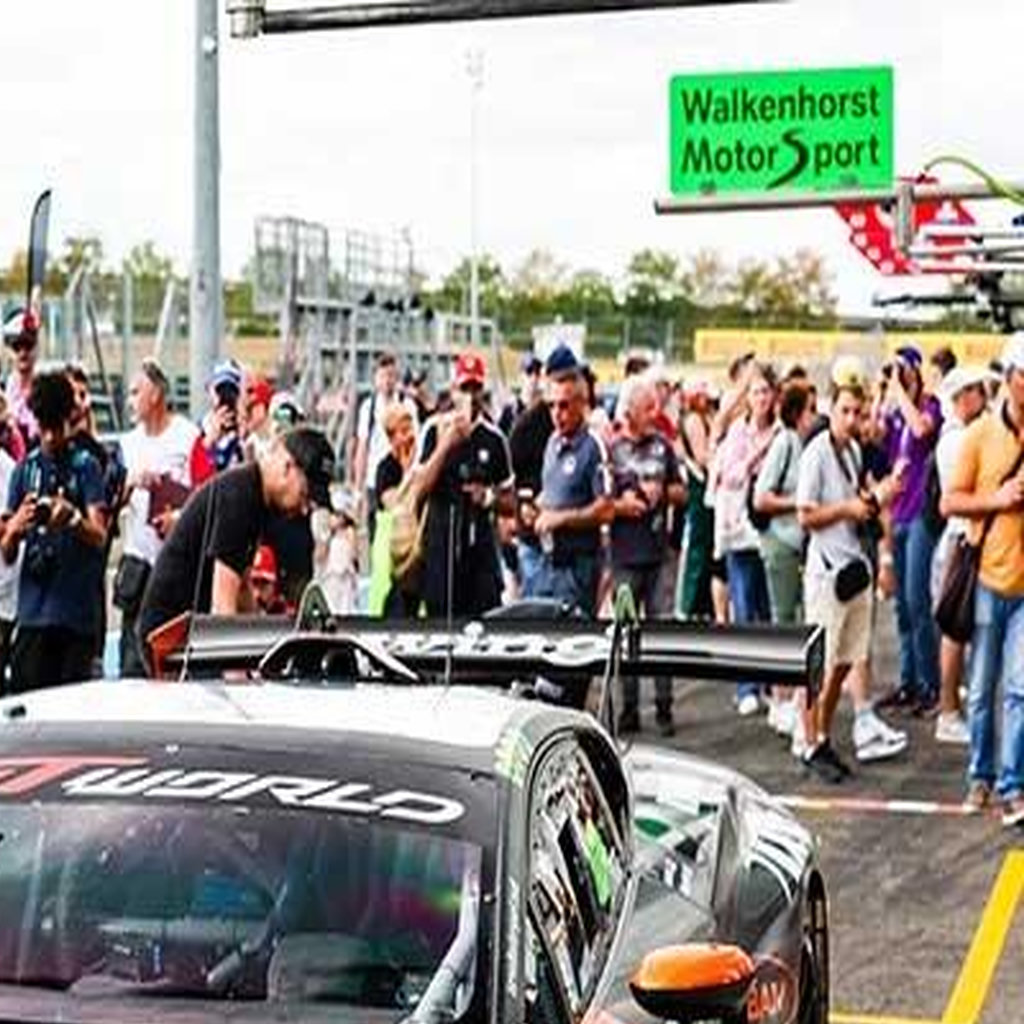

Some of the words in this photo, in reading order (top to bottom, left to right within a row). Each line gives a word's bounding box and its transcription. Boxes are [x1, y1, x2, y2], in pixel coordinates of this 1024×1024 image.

[680, 83, 881, 125] Walkenhorst
[681, 127, 880, 190] MotorSport
[61, 767, 467, 824] WORLD
